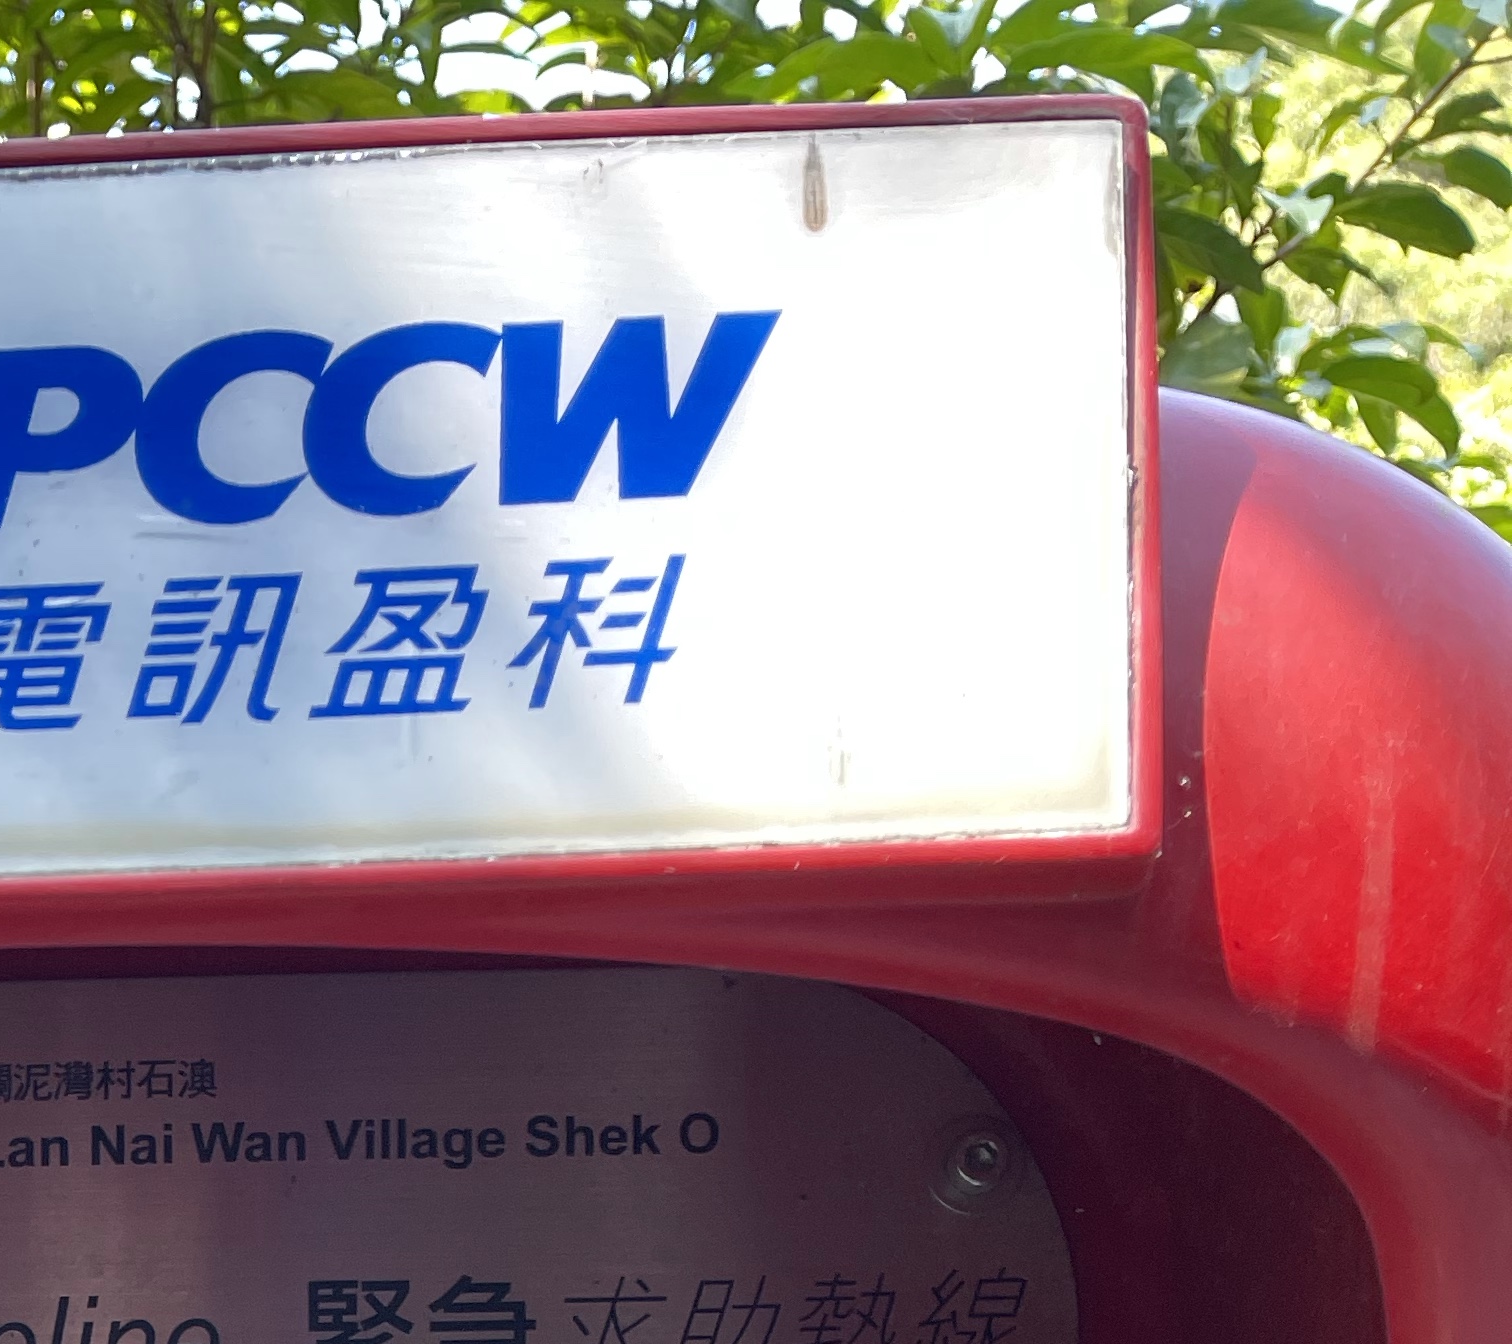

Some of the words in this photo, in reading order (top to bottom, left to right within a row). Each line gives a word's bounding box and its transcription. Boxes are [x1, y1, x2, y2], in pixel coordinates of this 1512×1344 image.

[91, 1123, 172, 1165] Nai
[192, 1122, 305, 1163] Wan
[326, 1118, 507, 1168] Village
[524, 1115, 661, 1158] Shek
[679, 1112, 720, 1155] O
